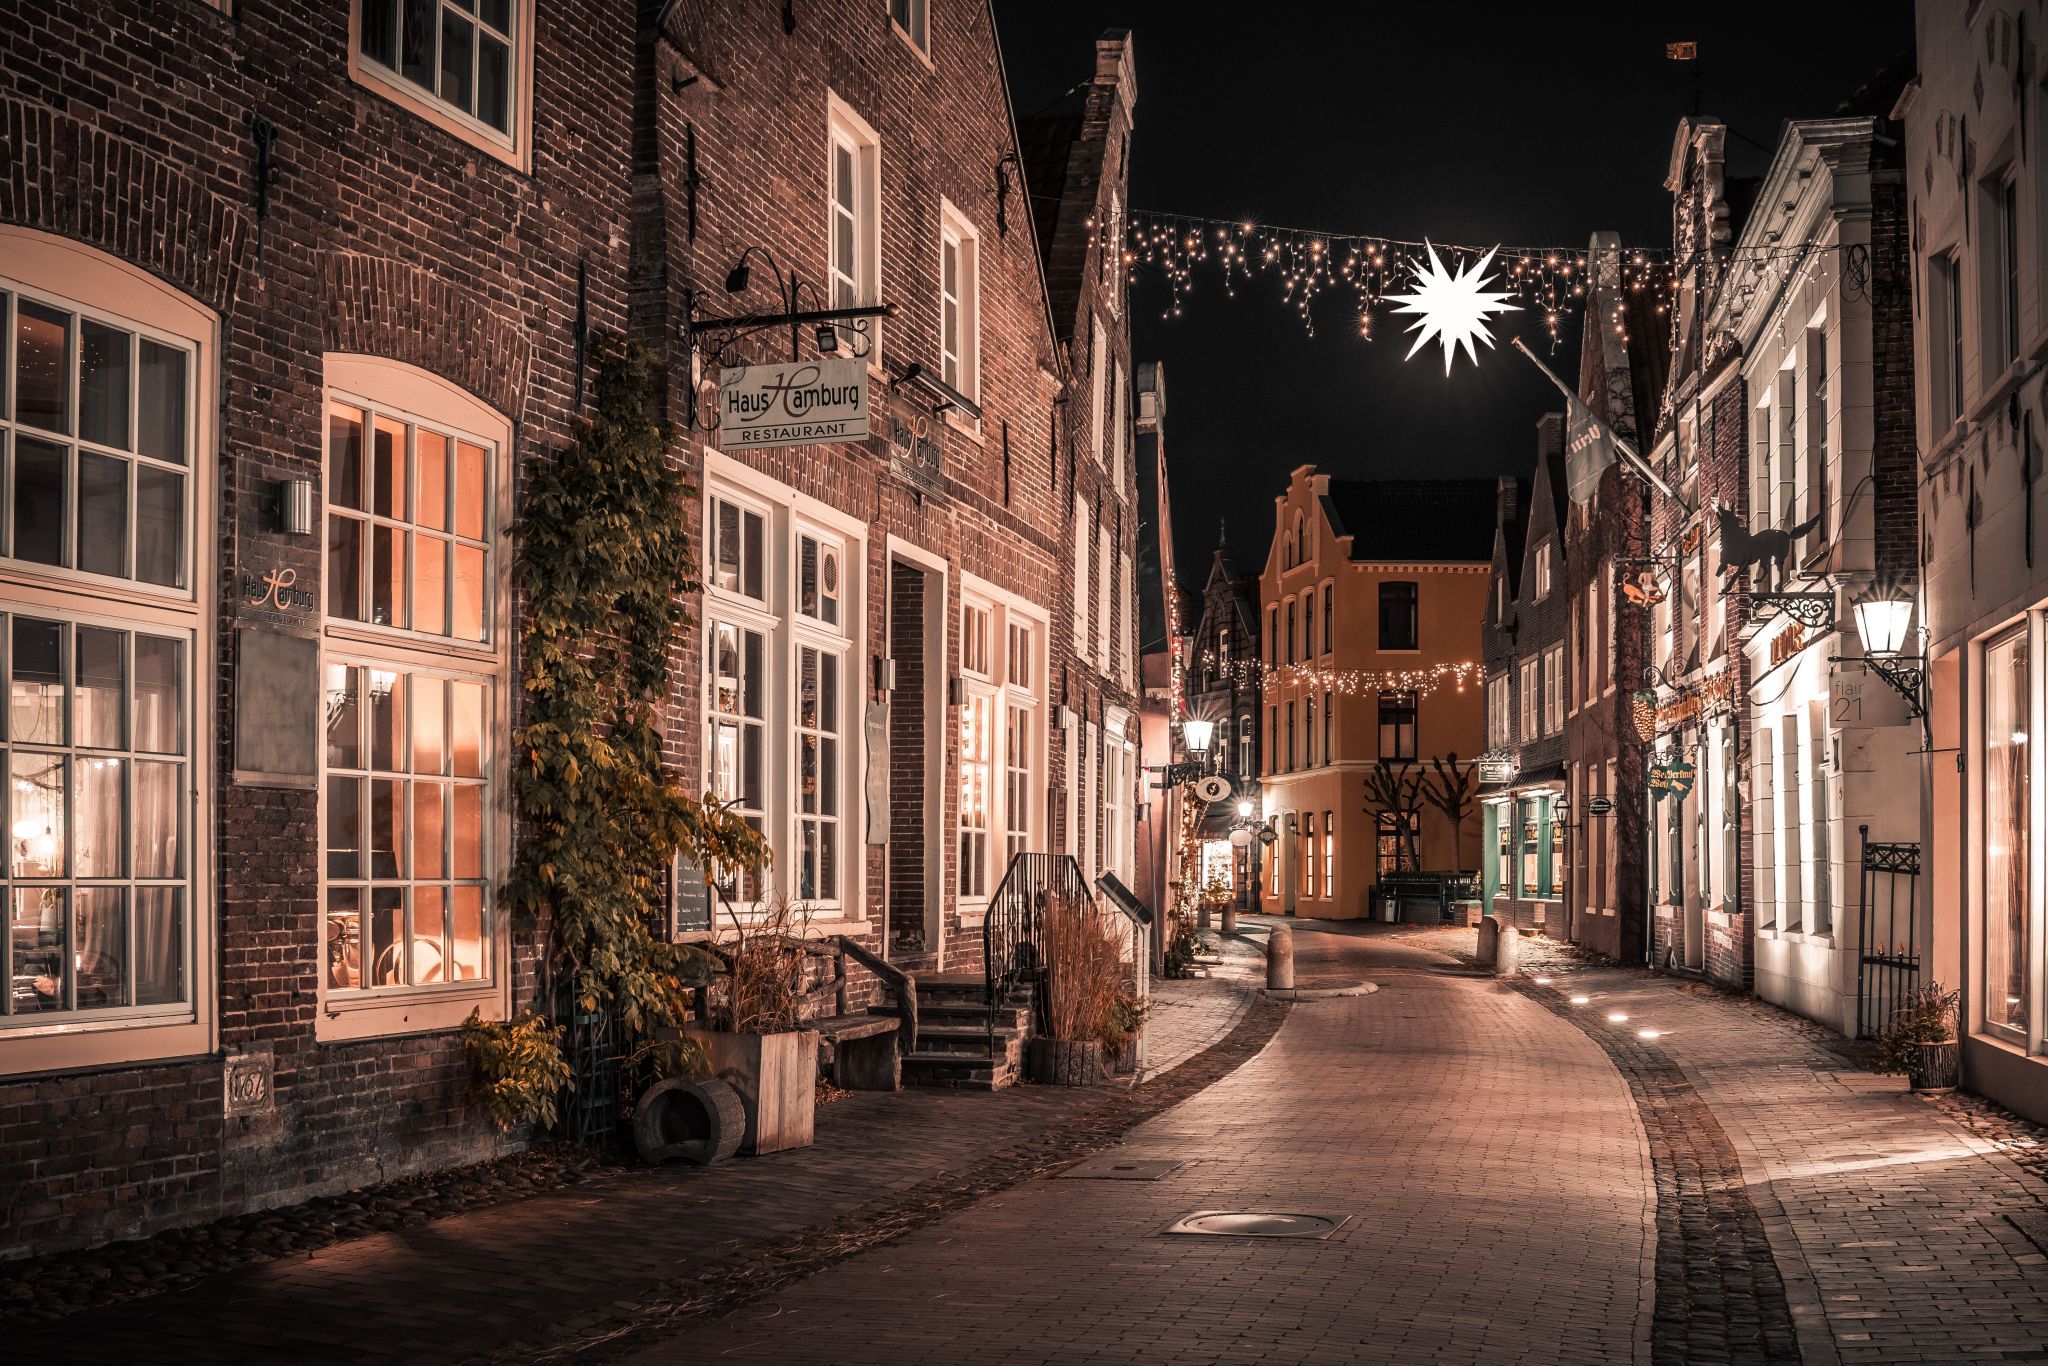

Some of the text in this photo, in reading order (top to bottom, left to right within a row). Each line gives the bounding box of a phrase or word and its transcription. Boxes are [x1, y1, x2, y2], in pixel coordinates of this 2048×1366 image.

[728, 365, 859, 422] Haus Hamburg
[742, 423, 846, 441] RESTAURANT
[1835, 680, 1864, 696] flair
[1835, 697, 1862, 722] 21
